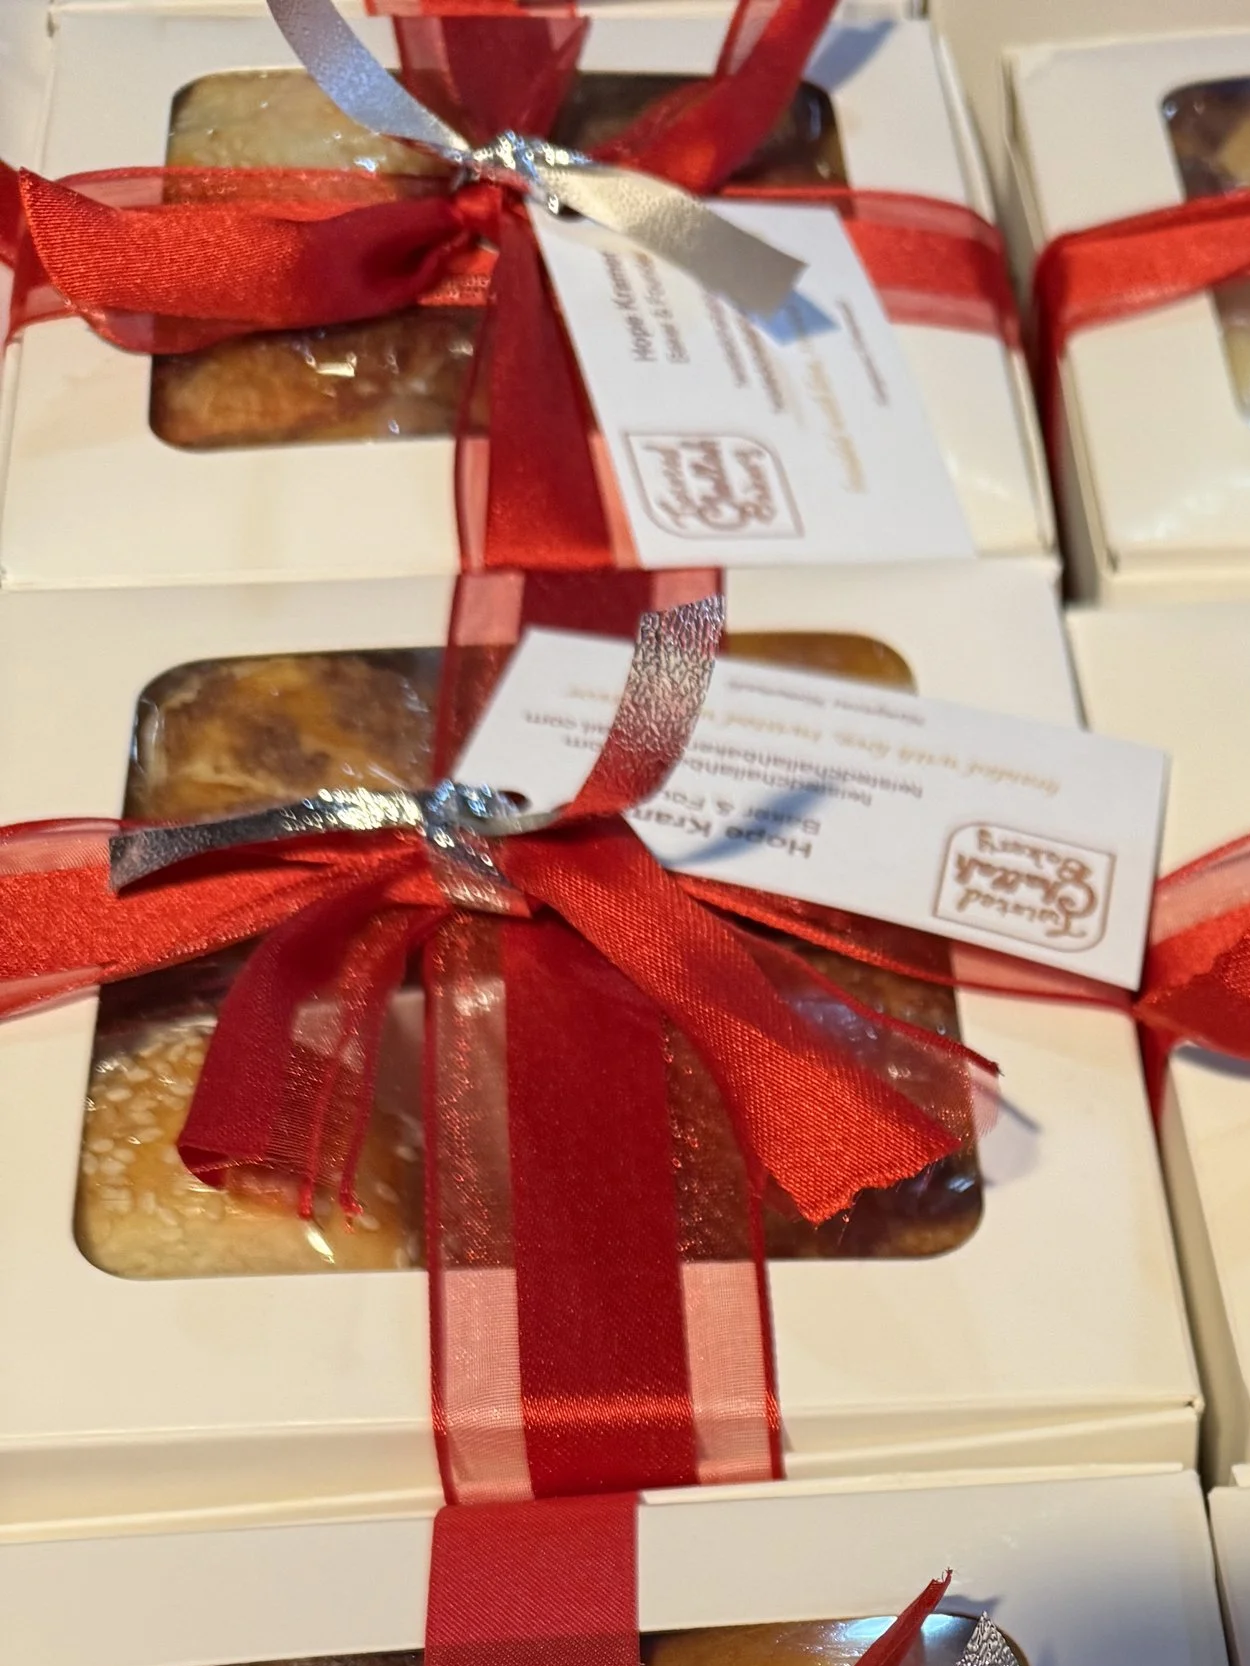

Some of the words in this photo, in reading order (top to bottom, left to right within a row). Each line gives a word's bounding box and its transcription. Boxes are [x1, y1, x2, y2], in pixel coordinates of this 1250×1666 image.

[722, 821, 813, 860] Hope
[953, 853, 1099, 919] Challah
[957, 886, 1089, 941] Twisted
